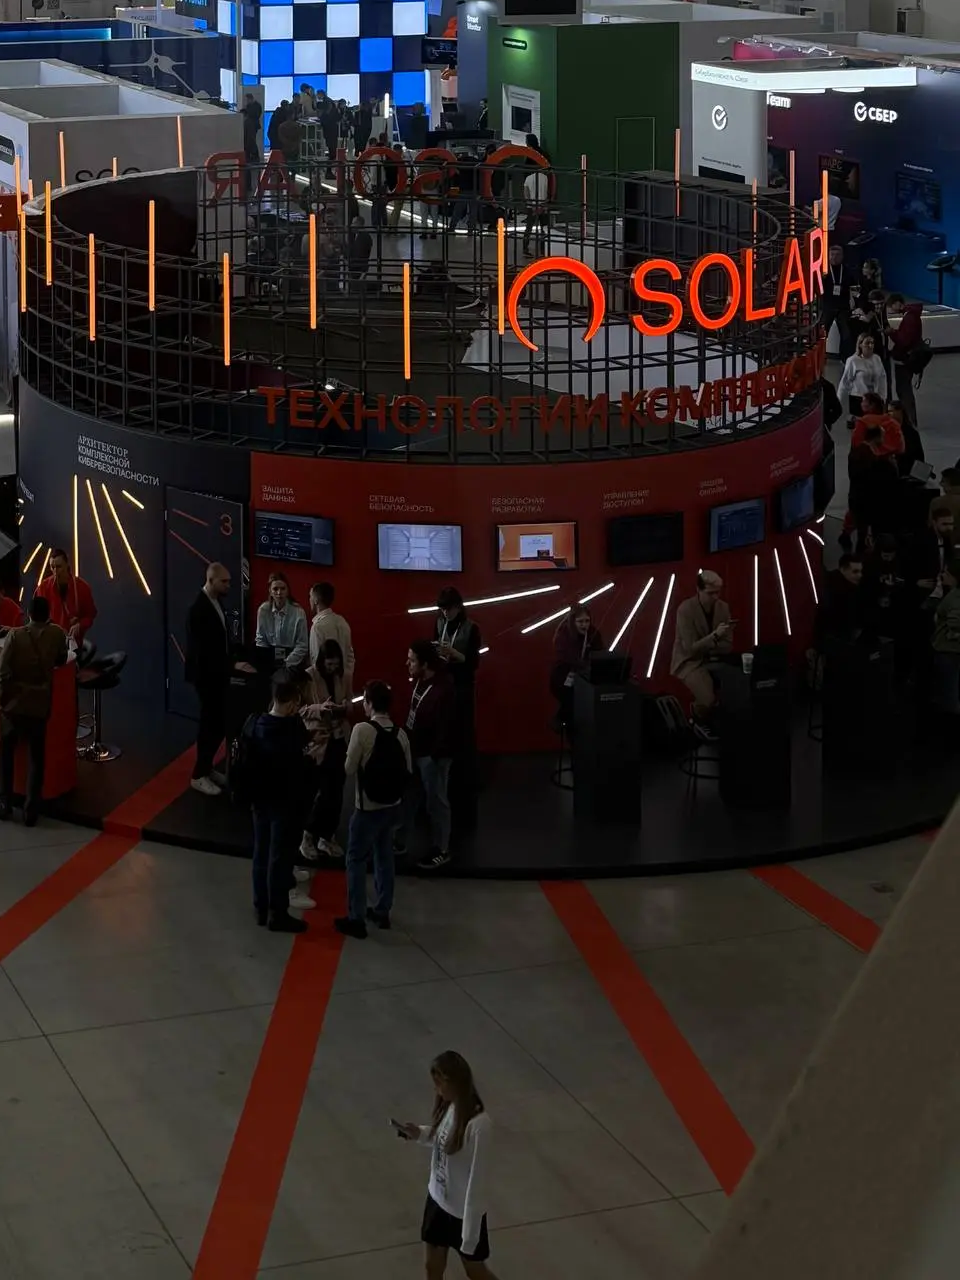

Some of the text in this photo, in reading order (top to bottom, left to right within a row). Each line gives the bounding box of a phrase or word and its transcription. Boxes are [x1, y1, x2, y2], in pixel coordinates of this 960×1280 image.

[868, 107, 899, 123] СБЕР
[631, 227, 825, 337] SOLAR
[257, 385, 608, 434] ТЕХНОЛОГИИ
[78, 435, 129, 458] АРХИТЕКТОР
[78, 445, 130, 468] КОМПЛЕКСНОЙ
[78, 454, 160, 486] КИБЕРБЕЗОПАСНОСТИ
[261, 485, 294, 495] ЗАЩИТА
